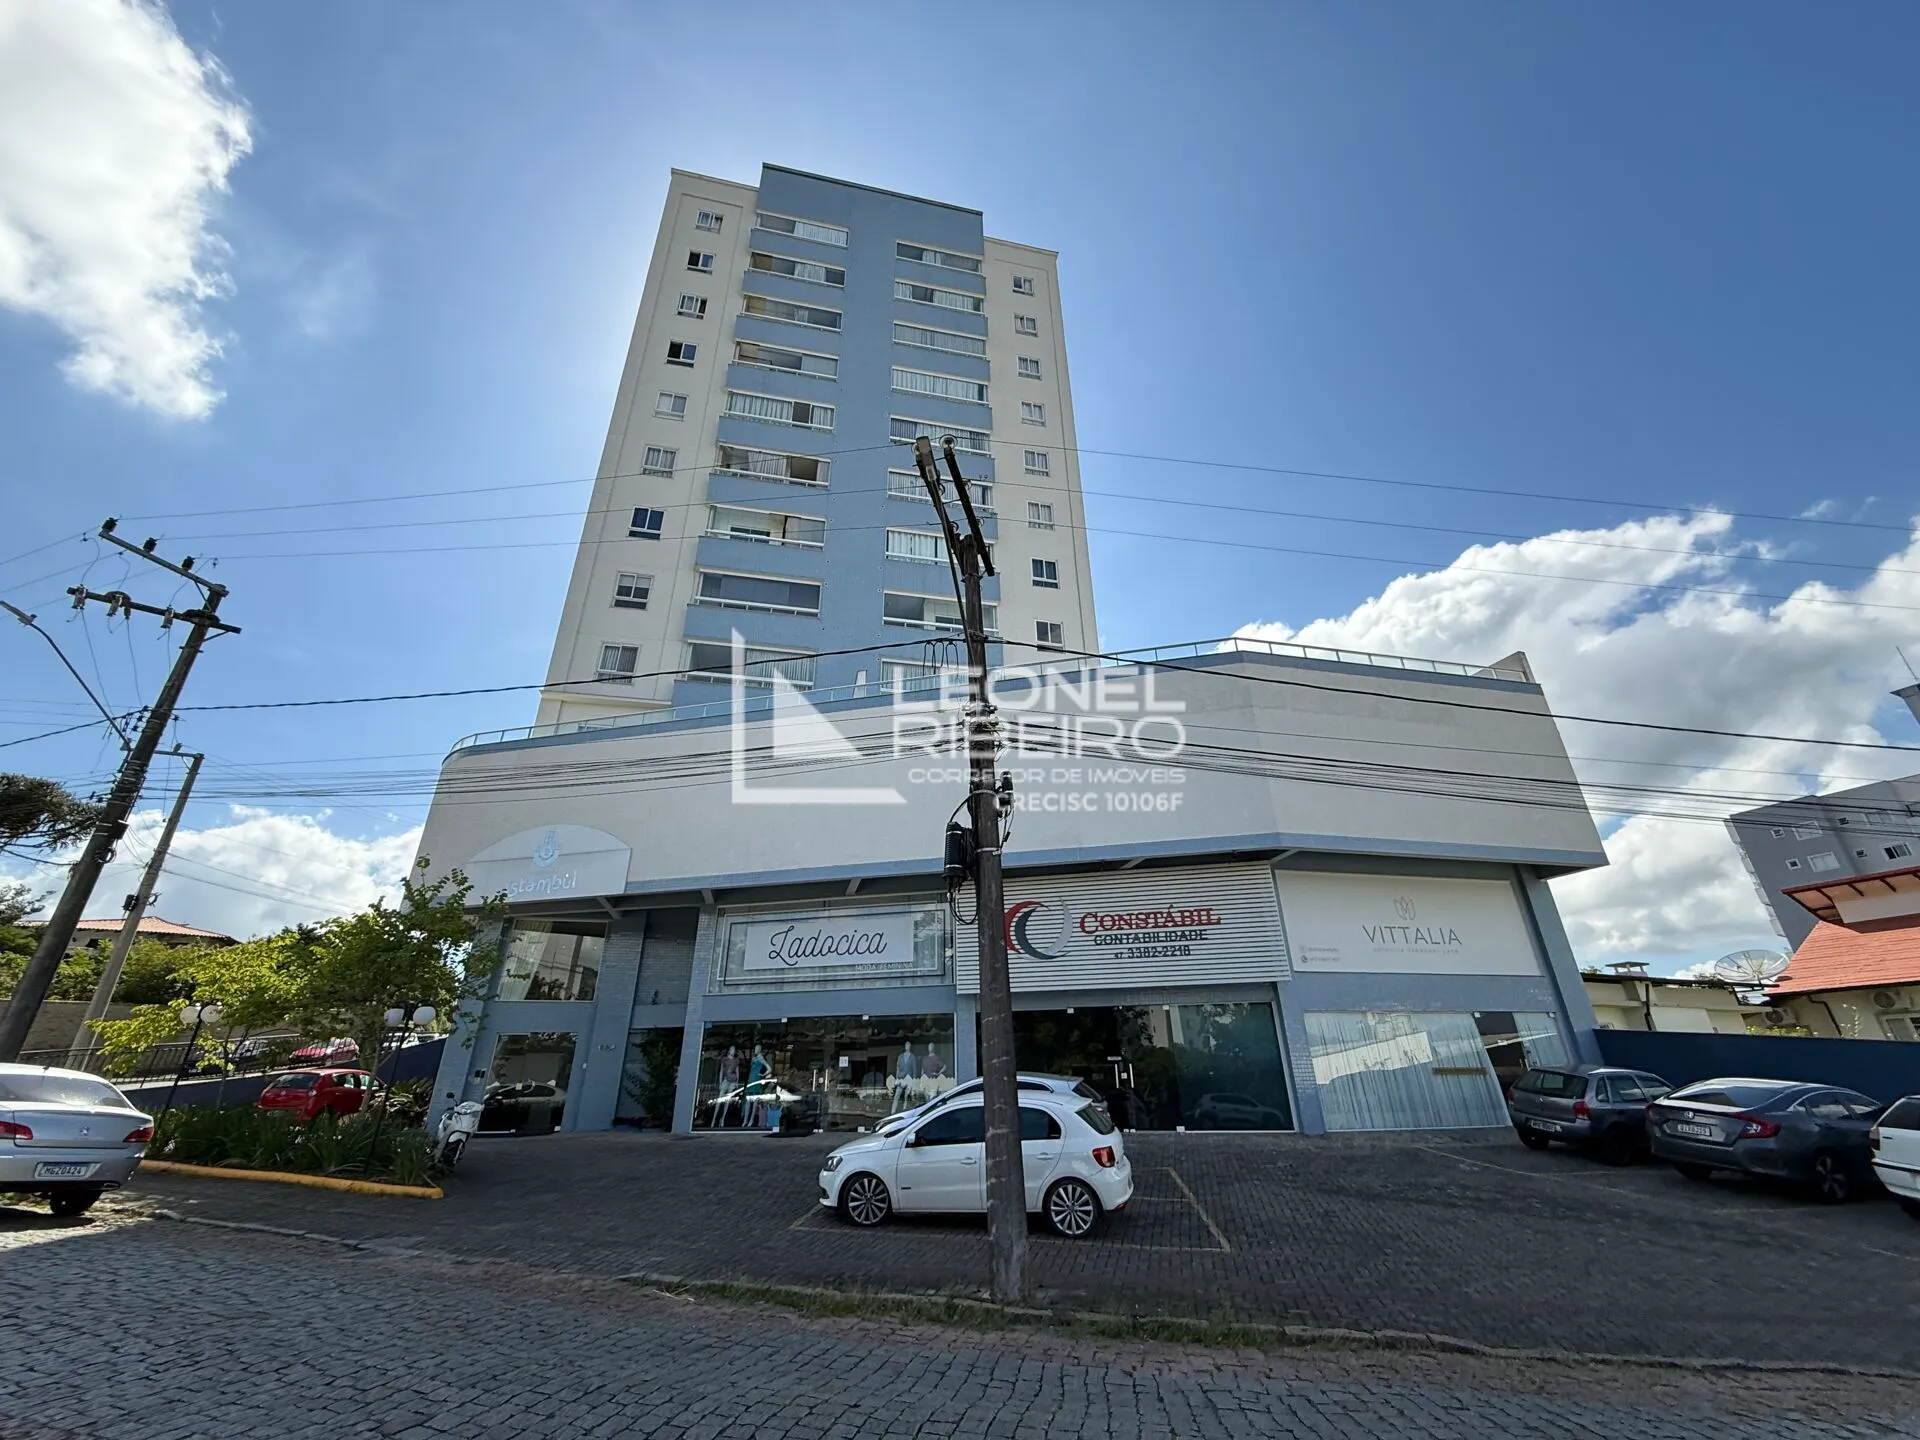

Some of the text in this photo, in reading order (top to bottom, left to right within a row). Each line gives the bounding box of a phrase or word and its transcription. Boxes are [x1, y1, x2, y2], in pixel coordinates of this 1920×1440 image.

[1080, 904, 1222, 934] CONSTÁBIL
[768, 924, 888, 967] Ladocica
[1093, 930, 1208, 945] CONTABILIDADE
[1362, 925, 1463, 945] VITTALIA
